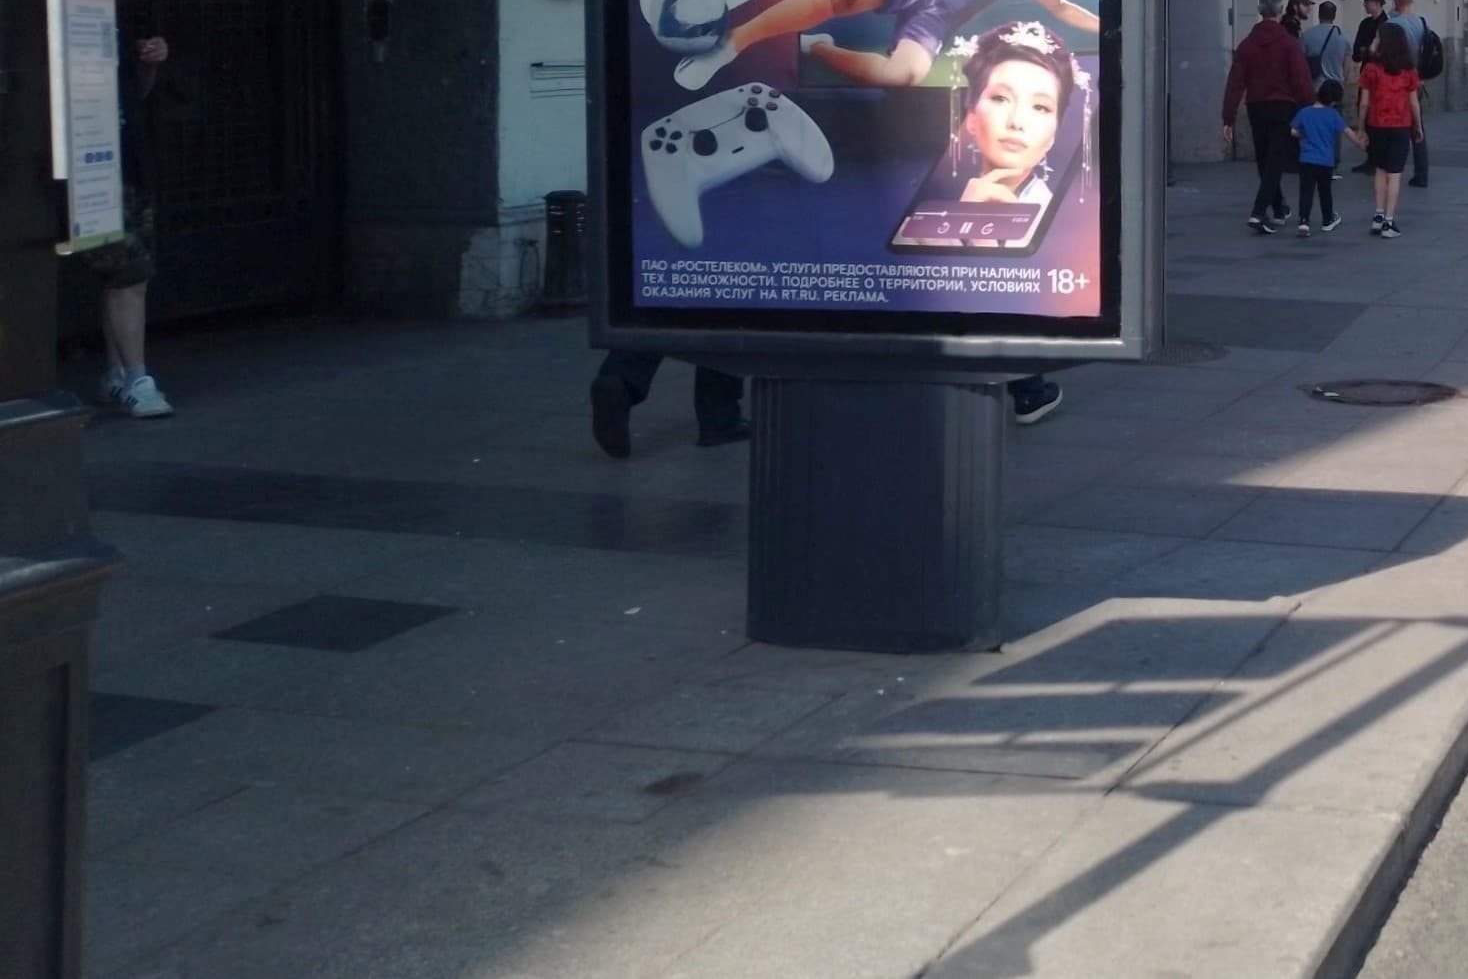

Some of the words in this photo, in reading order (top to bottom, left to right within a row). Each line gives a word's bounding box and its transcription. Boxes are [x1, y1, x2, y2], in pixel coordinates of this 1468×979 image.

[641, 259, 668, 271] ПАО
[772, 262, 821, 274] УСЛУГИ
[823, 263, 949, 278] ПРЕДОСТАВЛЯЮТСЯ
[951, 266, 977, 277] ПРИ
[980, 267, 1041, 279] НАЛИЧИИ
[671, 273, 777, 287] ВОЗМОЖНОСТИ.
[781, 276, 860, 289] ПОДРОБНЕЕ
[864, 277, 874, 289] О
[971, 281, 1041, 293] УСЛОВИЯХ
[1047, 268, 1091, 294] 18+
[642, 286, 711, 298] ОКАЗАНИЯ
[714, 287, 755, 300] УСЛУГ
[759, 289, 778, 300] НА
[781, 290, 820, 301] RT.RU.
[823, 290, 889, 303] РЕКЛАМА.
